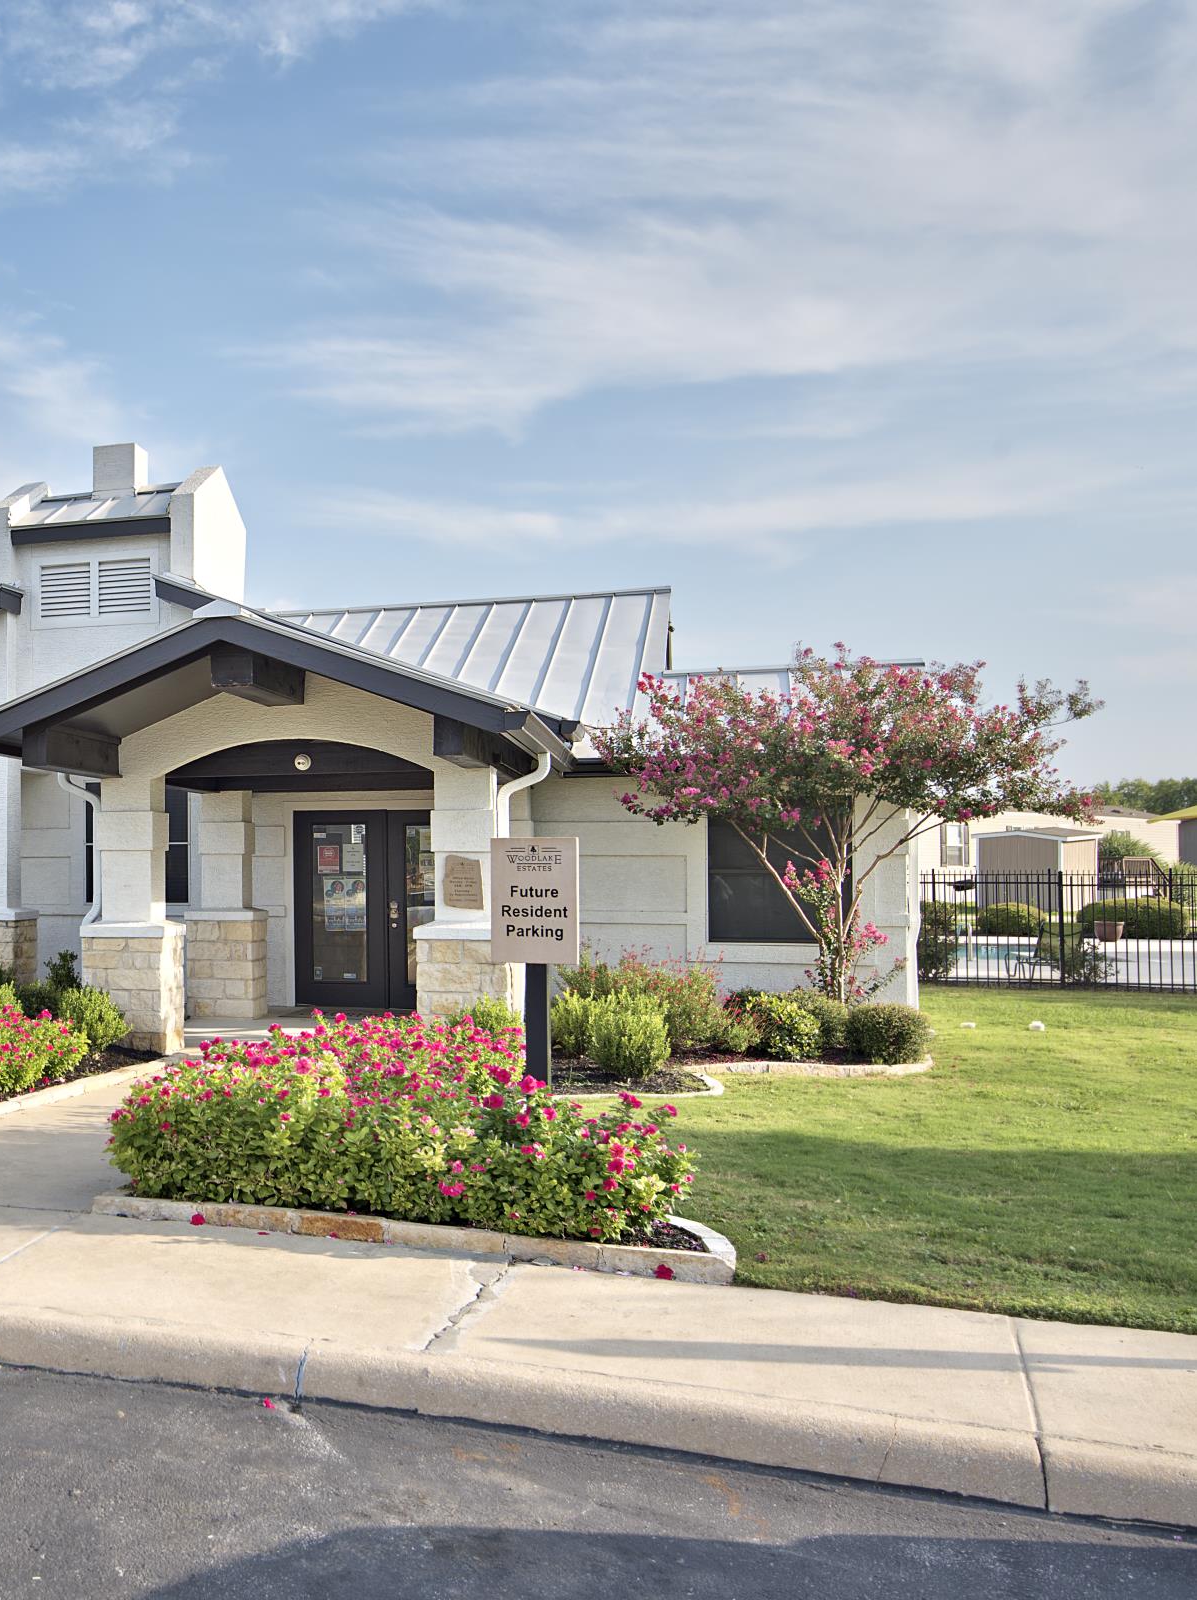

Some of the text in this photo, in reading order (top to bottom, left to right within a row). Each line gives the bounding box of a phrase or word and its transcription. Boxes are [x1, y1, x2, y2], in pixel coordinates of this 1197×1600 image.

[506, 854, 562, 865] WOODLAKE
[510, 885, 559, 898] Future
[501, 904, 568, 918] Resident
[506, 924, 564, 941] Parking
